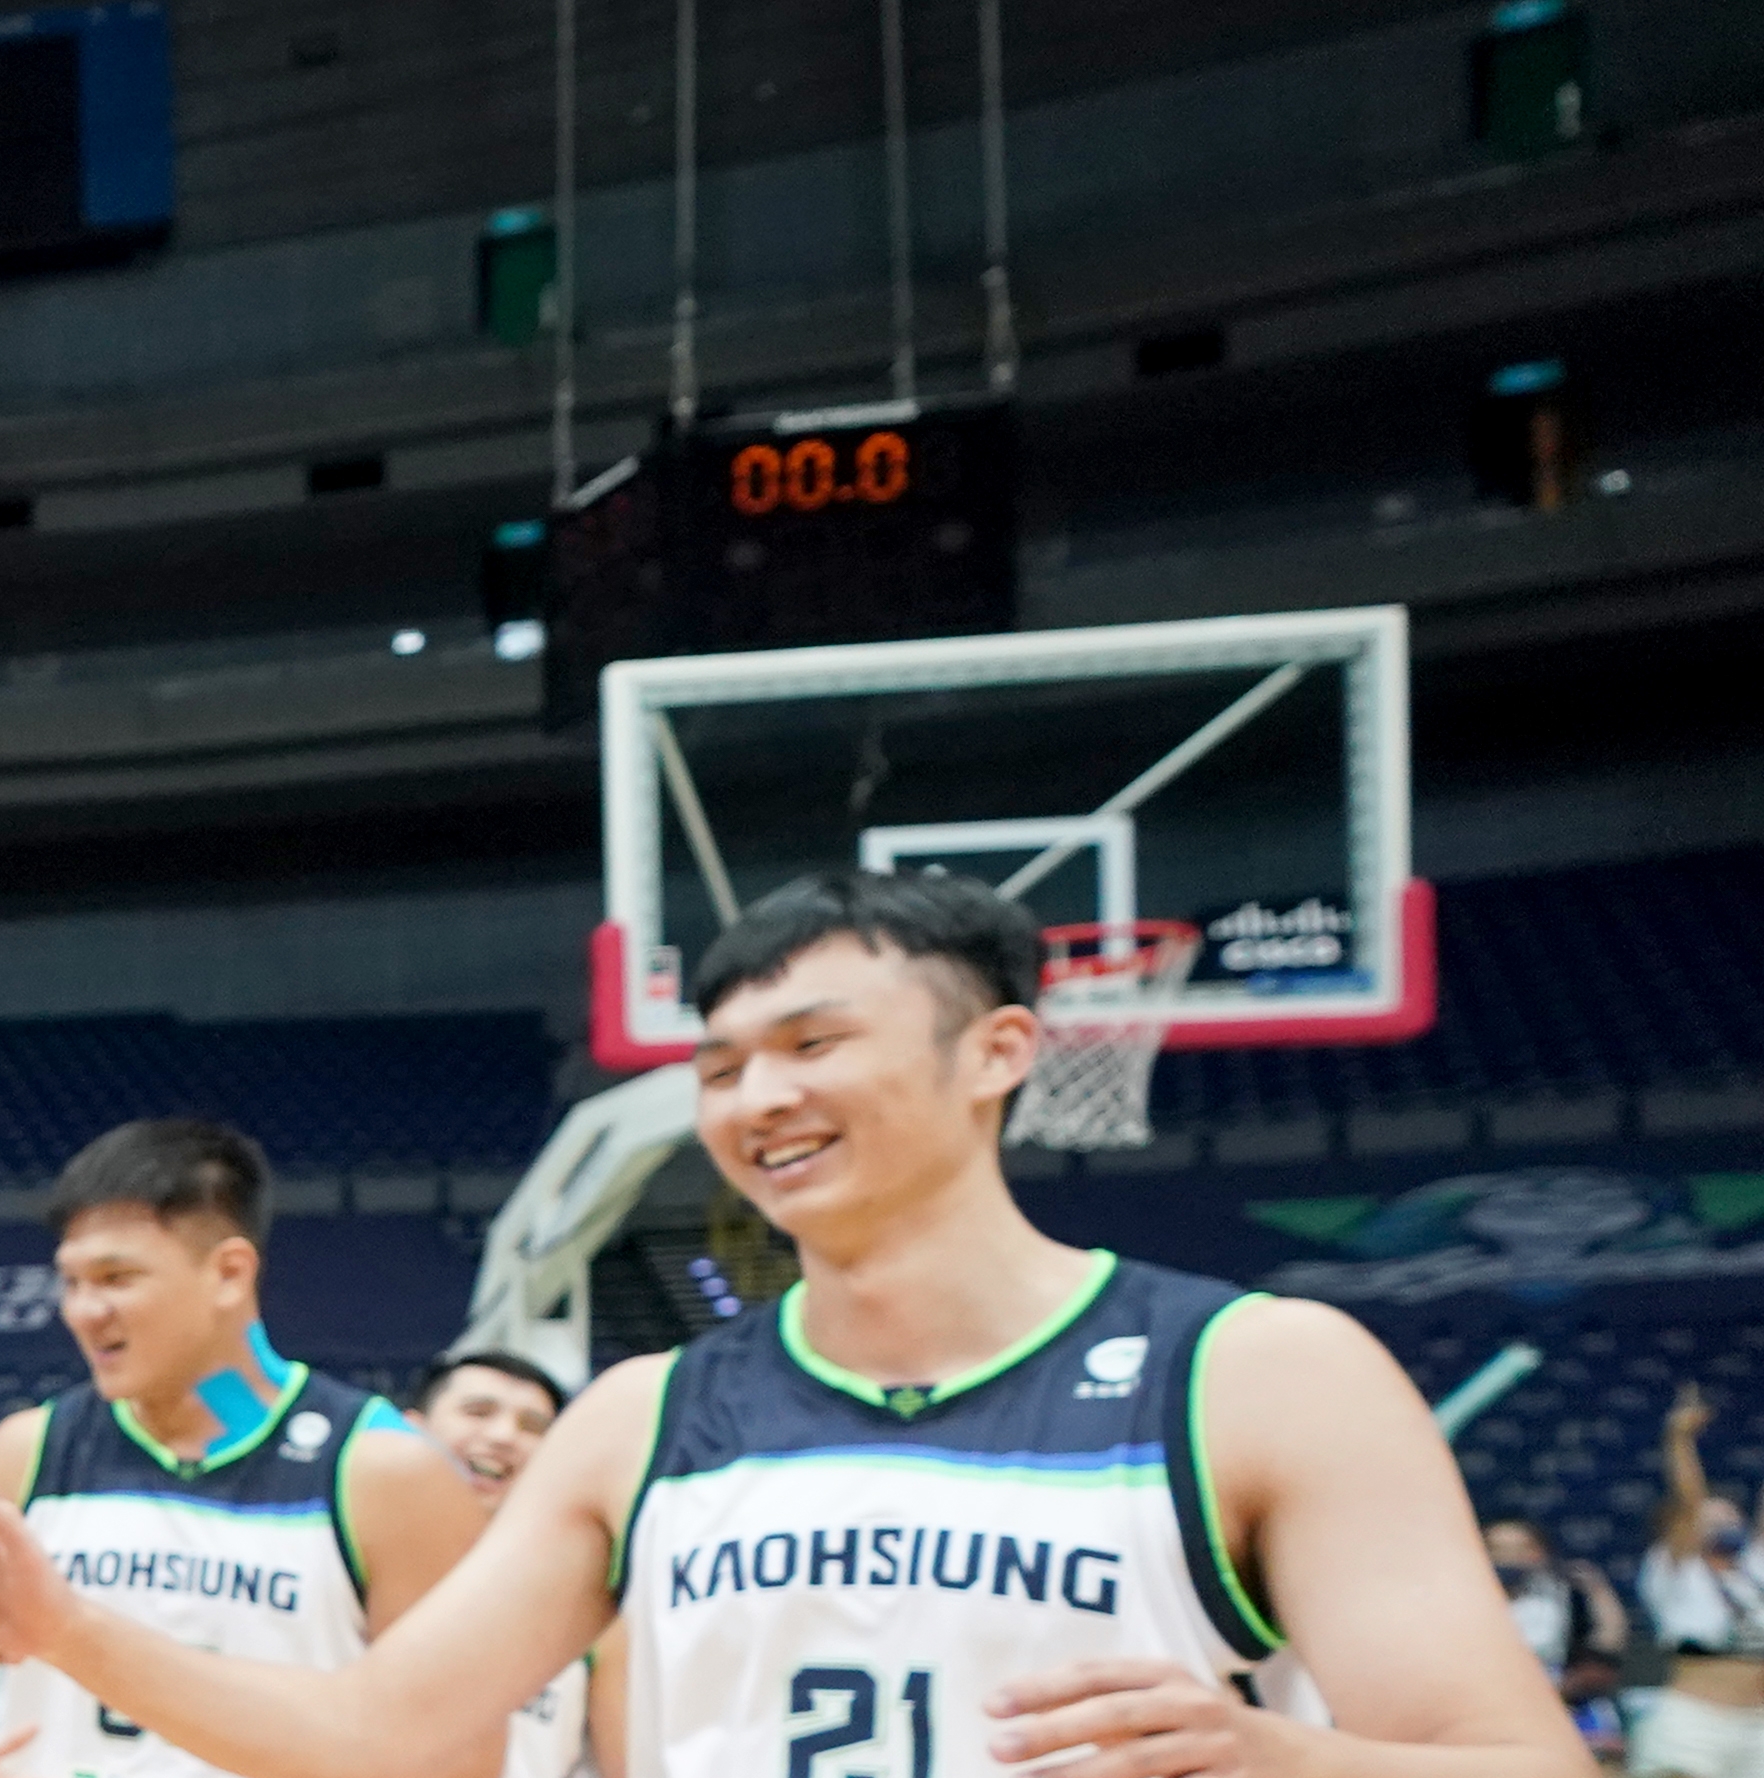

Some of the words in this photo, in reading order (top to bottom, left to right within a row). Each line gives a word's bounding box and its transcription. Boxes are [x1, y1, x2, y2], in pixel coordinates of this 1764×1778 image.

[731, 431, 910, 515] 00.0
[52, 1549, 302, 1613] AOHSIUNG
[672, 1527, 1122, 1616] KAOHSIUNG
